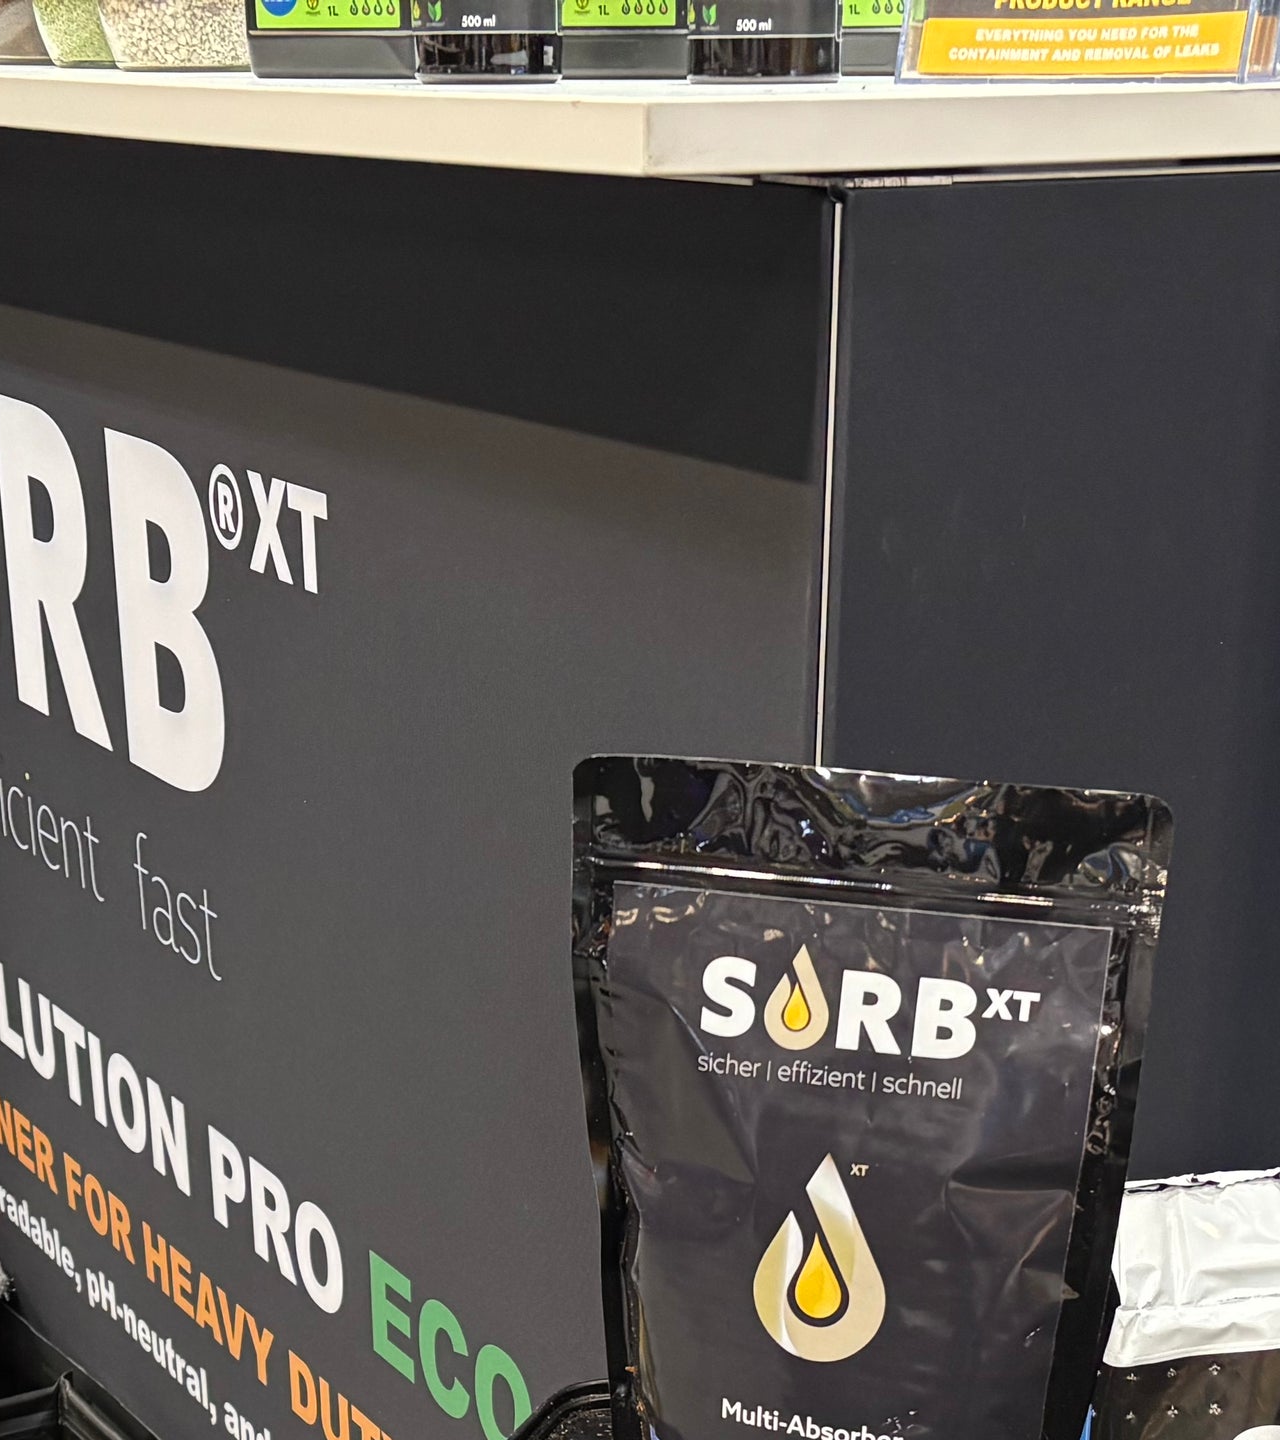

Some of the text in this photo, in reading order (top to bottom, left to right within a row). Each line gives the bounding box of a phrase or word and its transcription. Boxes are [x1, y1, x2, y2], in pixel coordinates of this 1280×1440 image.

[461, 14, 496, 28] 500 ml
[736, 18, 772, 31] 500 ml
[975, 24, 1200, 43] EVERYTHING YOU NEED FOR THE
[948, 43, 1220, 62] CONTAINMENT AND REMOVAL OF LEAKS
[133, 832, 222, 981] fast
[697, 1051, 963, 1101] sicher effizient schnell
[849, 1162, 870, 1178] XT
[207, 1123, 344, 1316] PRO
[63, 1151, 136, 1264] FOR
[143, 1222, 277, 1389] HEAVY
[85, 1266, 219, 1425] pH-neutral,
